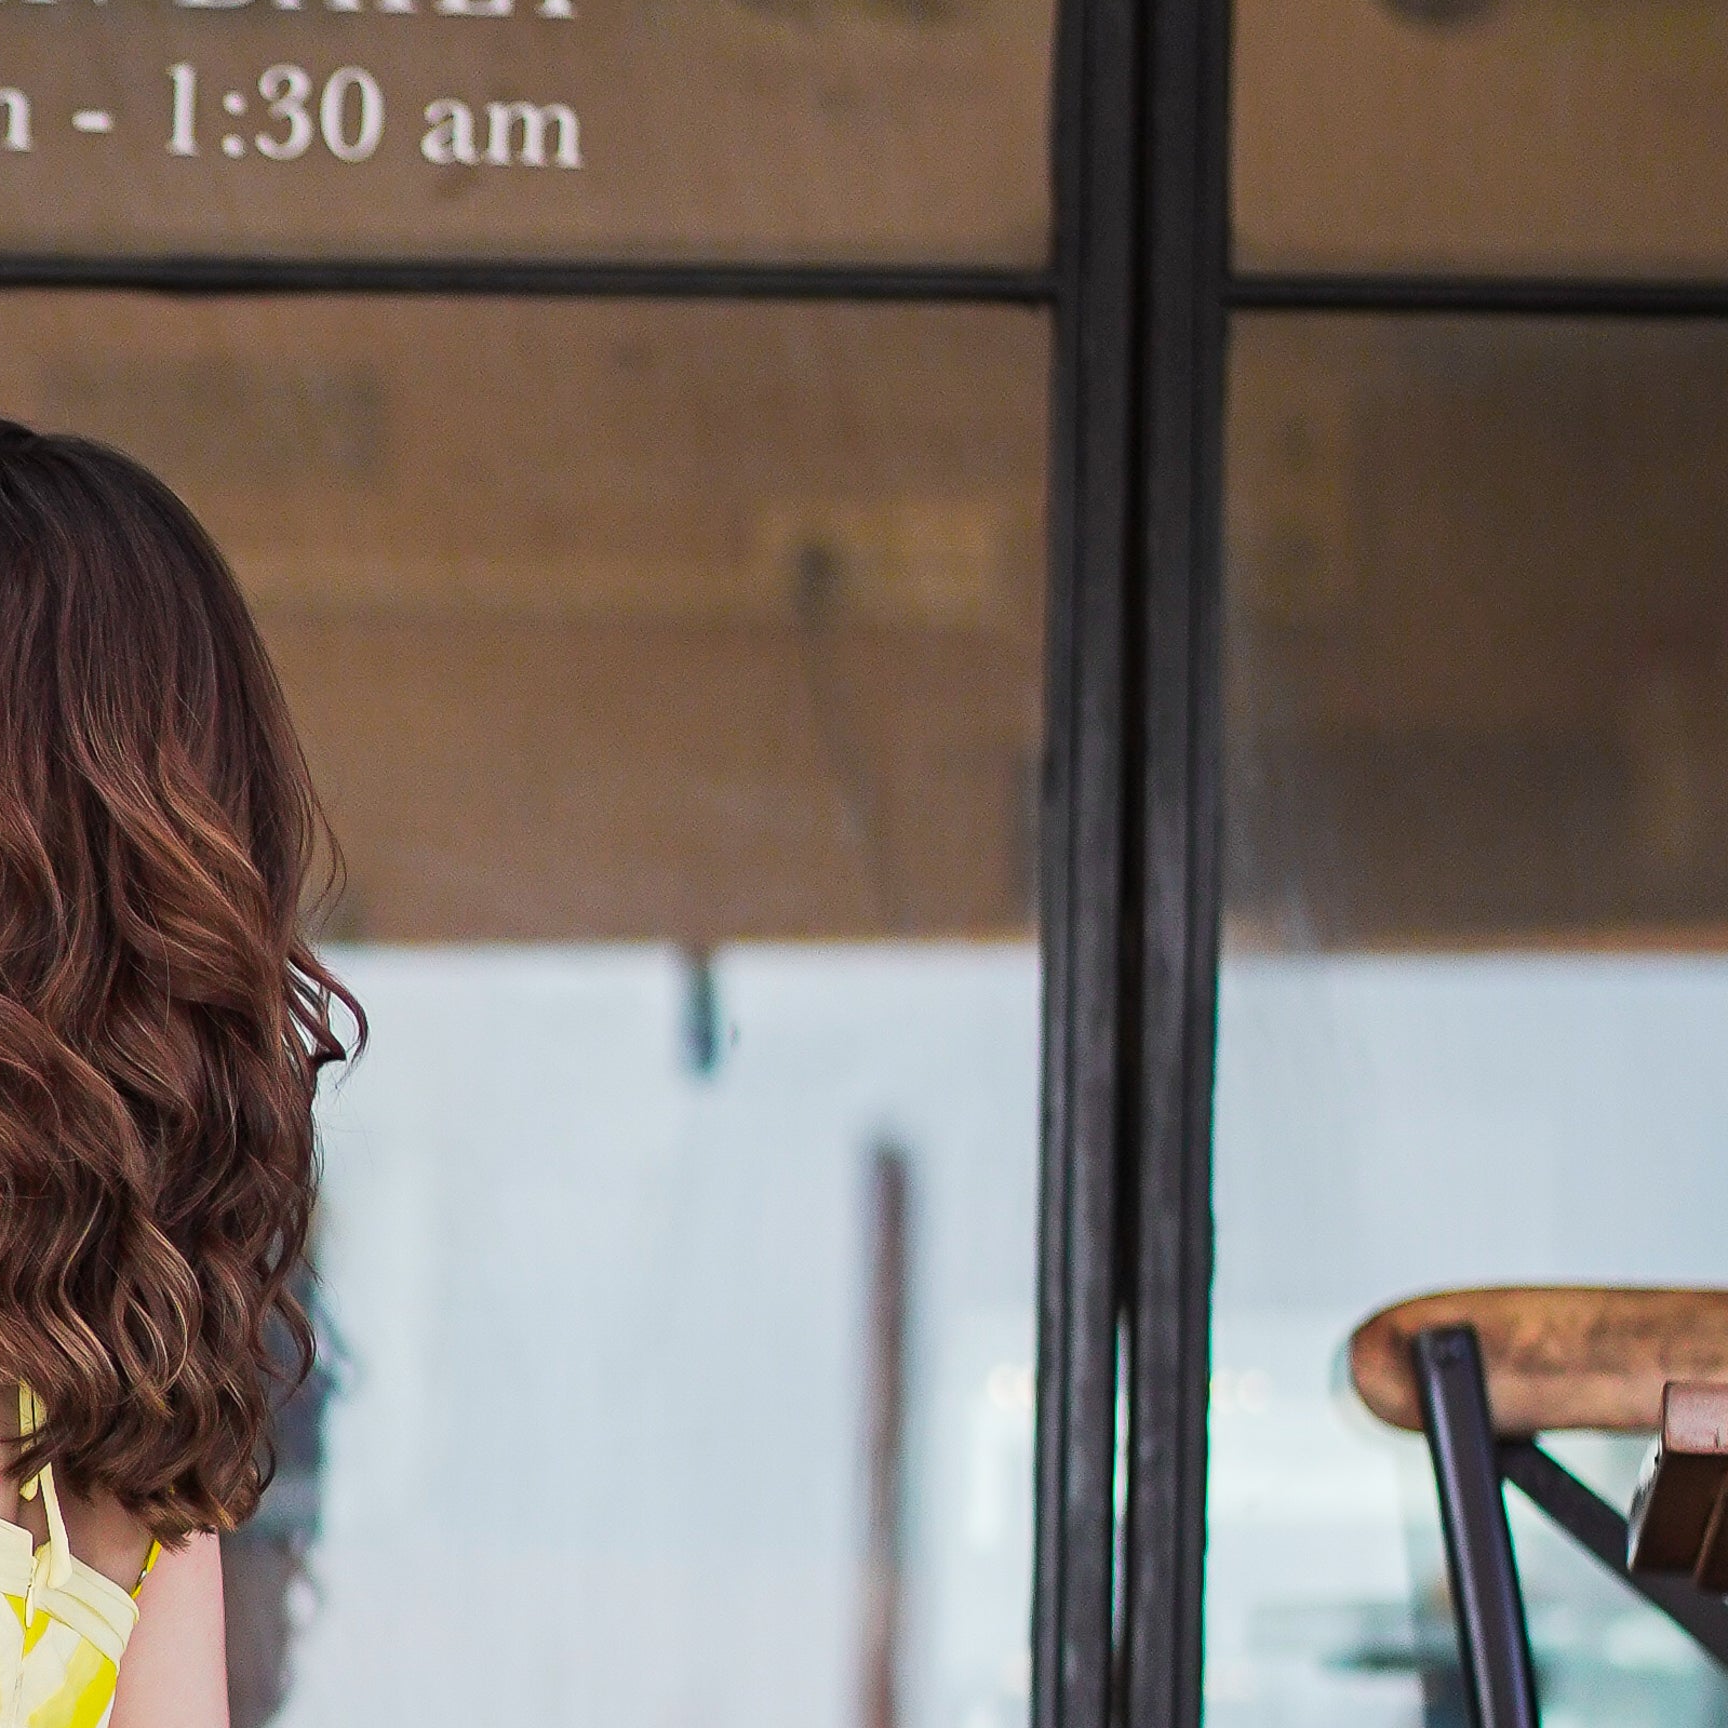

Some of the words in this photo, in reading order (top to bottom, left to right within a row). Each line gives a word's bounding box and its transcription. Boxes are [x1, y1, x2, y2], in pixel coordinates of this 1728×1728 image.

[72, 110, 113, 132] -
[169, 63, 384, 161] 1:30
[420, 99, 582, 169] am
